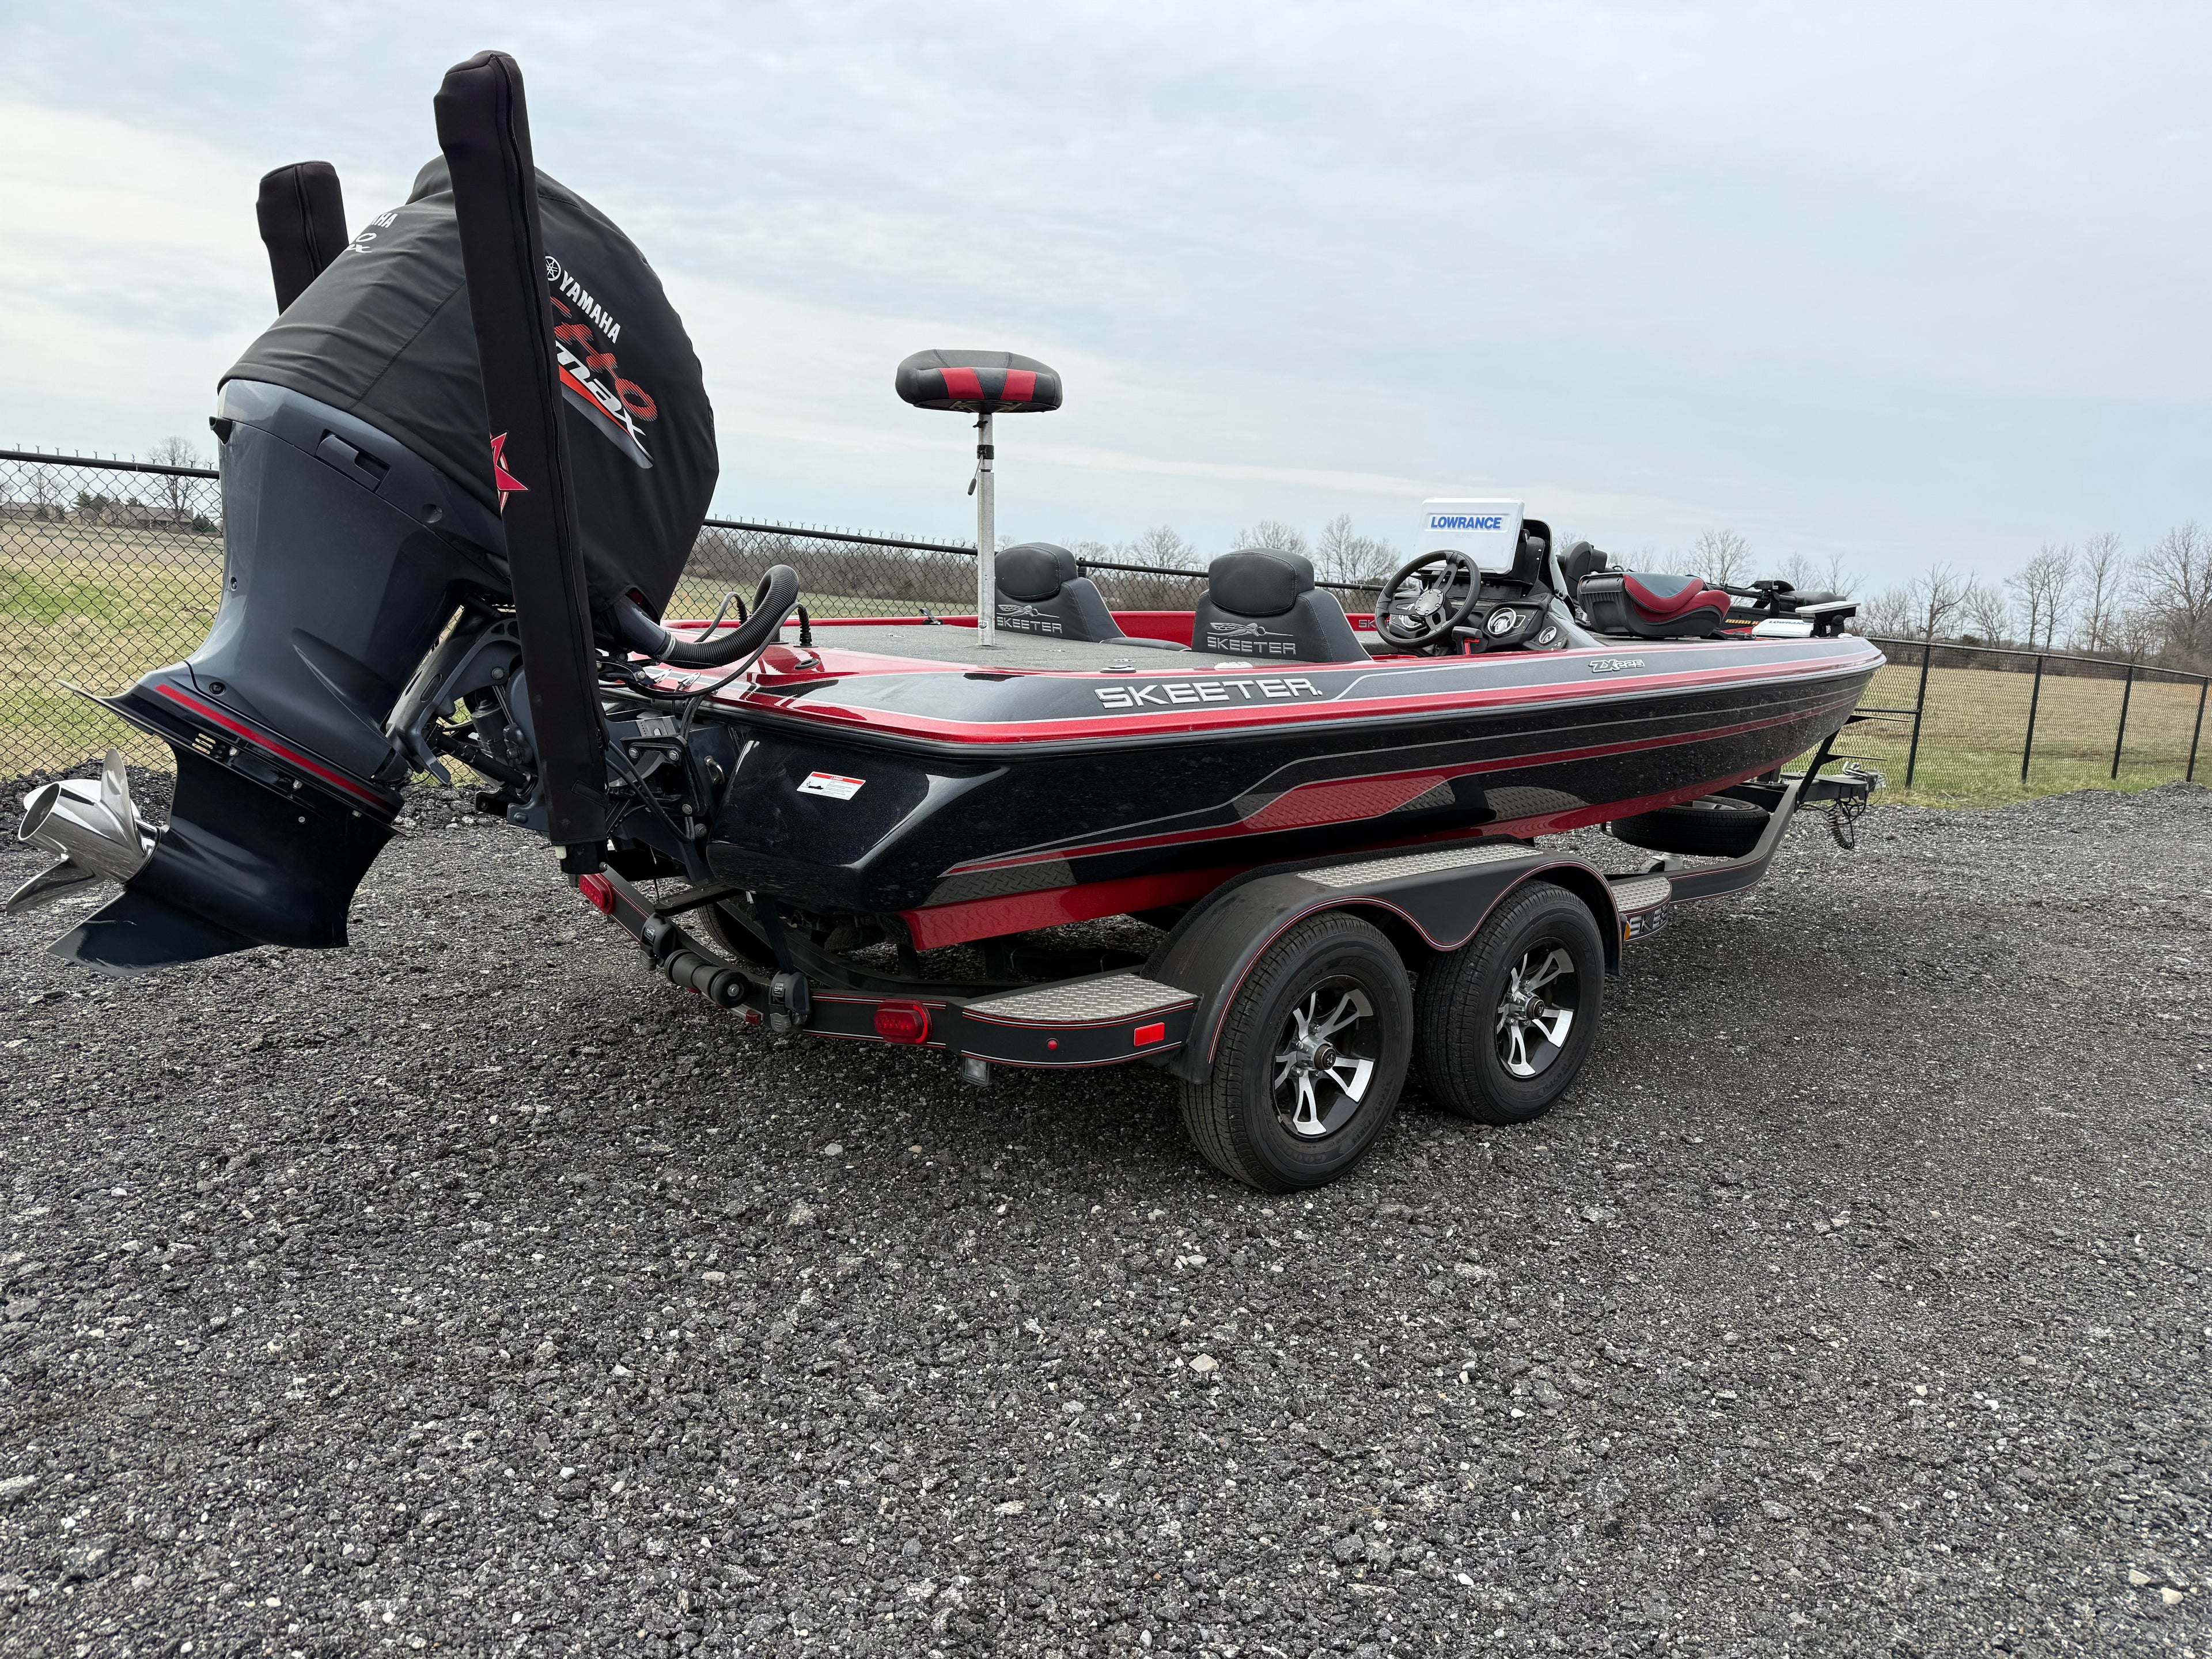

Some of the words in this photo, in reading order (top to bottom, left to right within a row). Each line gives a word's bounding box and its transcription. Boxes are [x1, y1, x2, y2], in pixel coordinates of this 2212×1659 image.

[559, 270, 621, 344] YAMAHA
[1431, 516, 1502, 529] LOWRANCE
[997, 616, 1063, 634] SKEETER
[1207, 637, 1296, 655] SKEETER
[1589, 658, 1645, 673] ZX225
